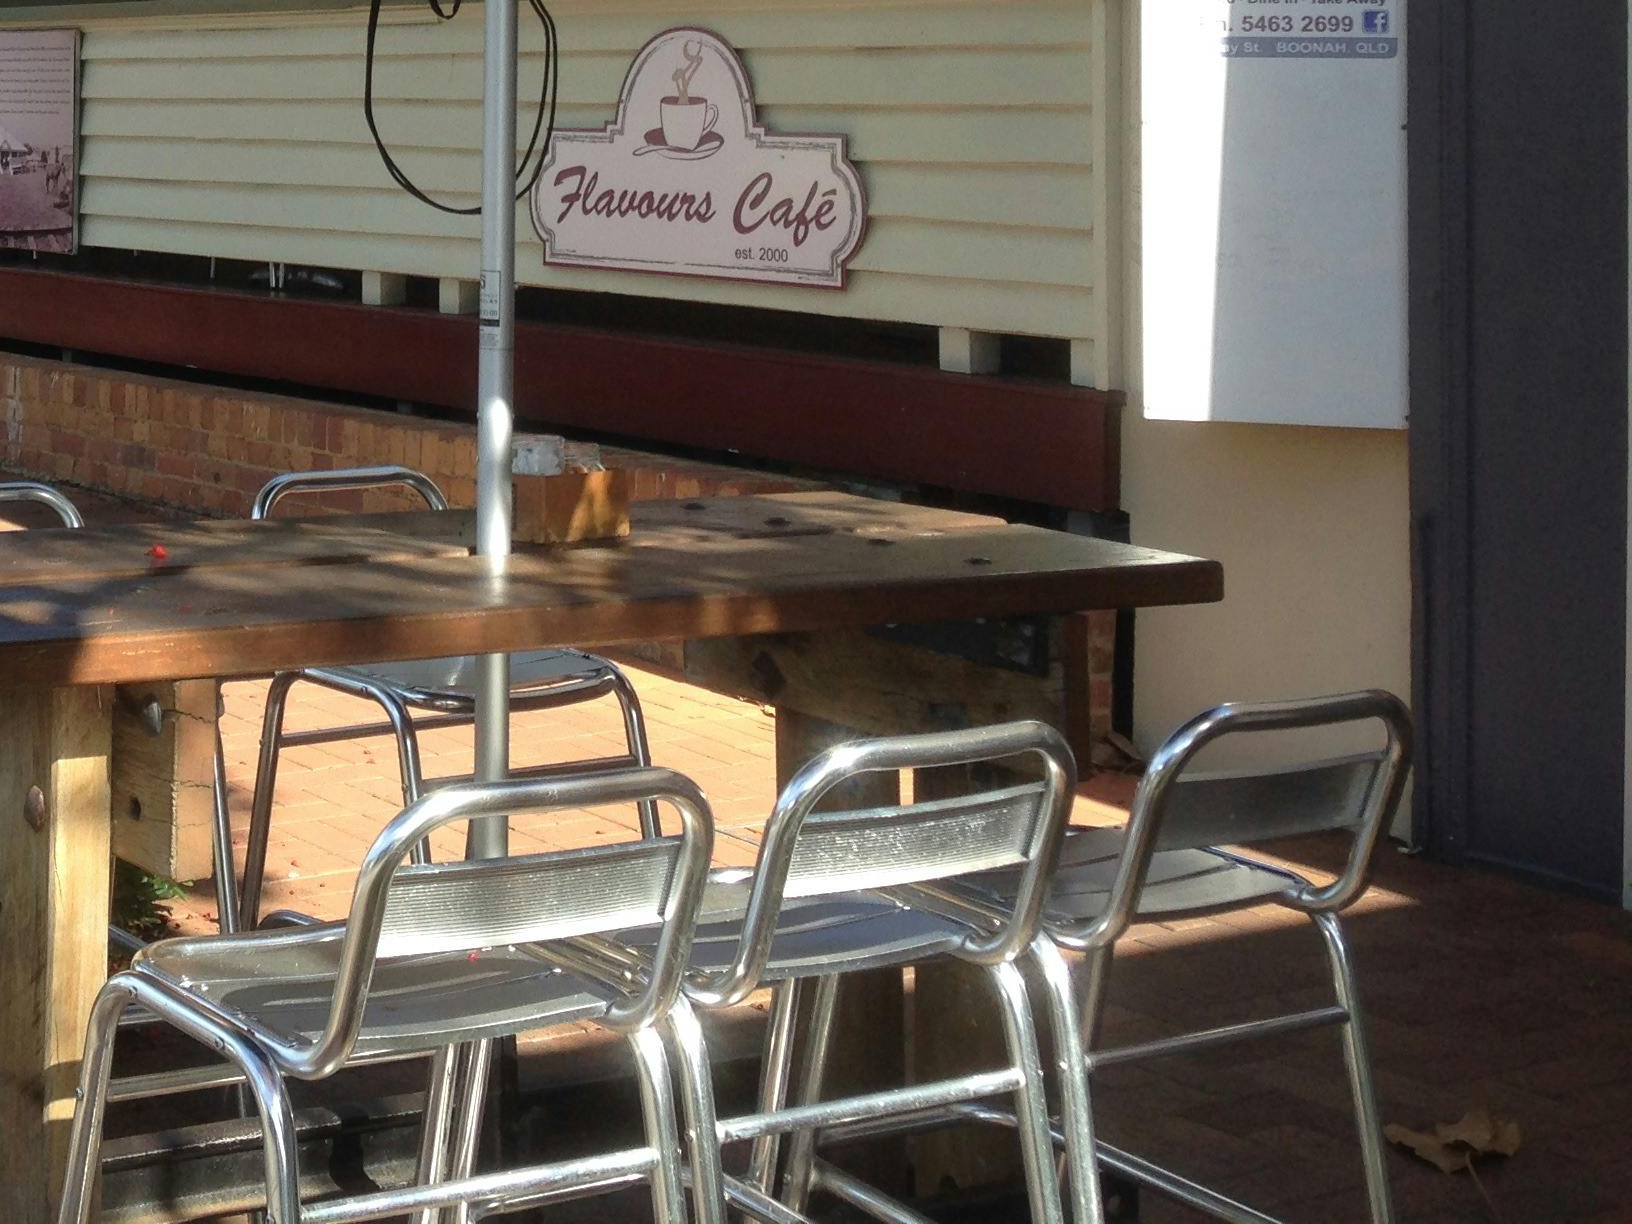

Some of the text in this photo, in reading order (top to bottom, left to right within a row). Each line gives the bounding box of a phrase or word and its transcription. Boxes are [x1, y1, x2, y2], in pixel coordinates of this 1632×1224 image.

[1241, 15, 1294, 32] 5463
[1301, 15, 1354, 32] 2699
[1356, 42, 1389, 54] QLD
[554, 165, 837, 247] Flavours Café
[759, 247, 788, 262] 2000
